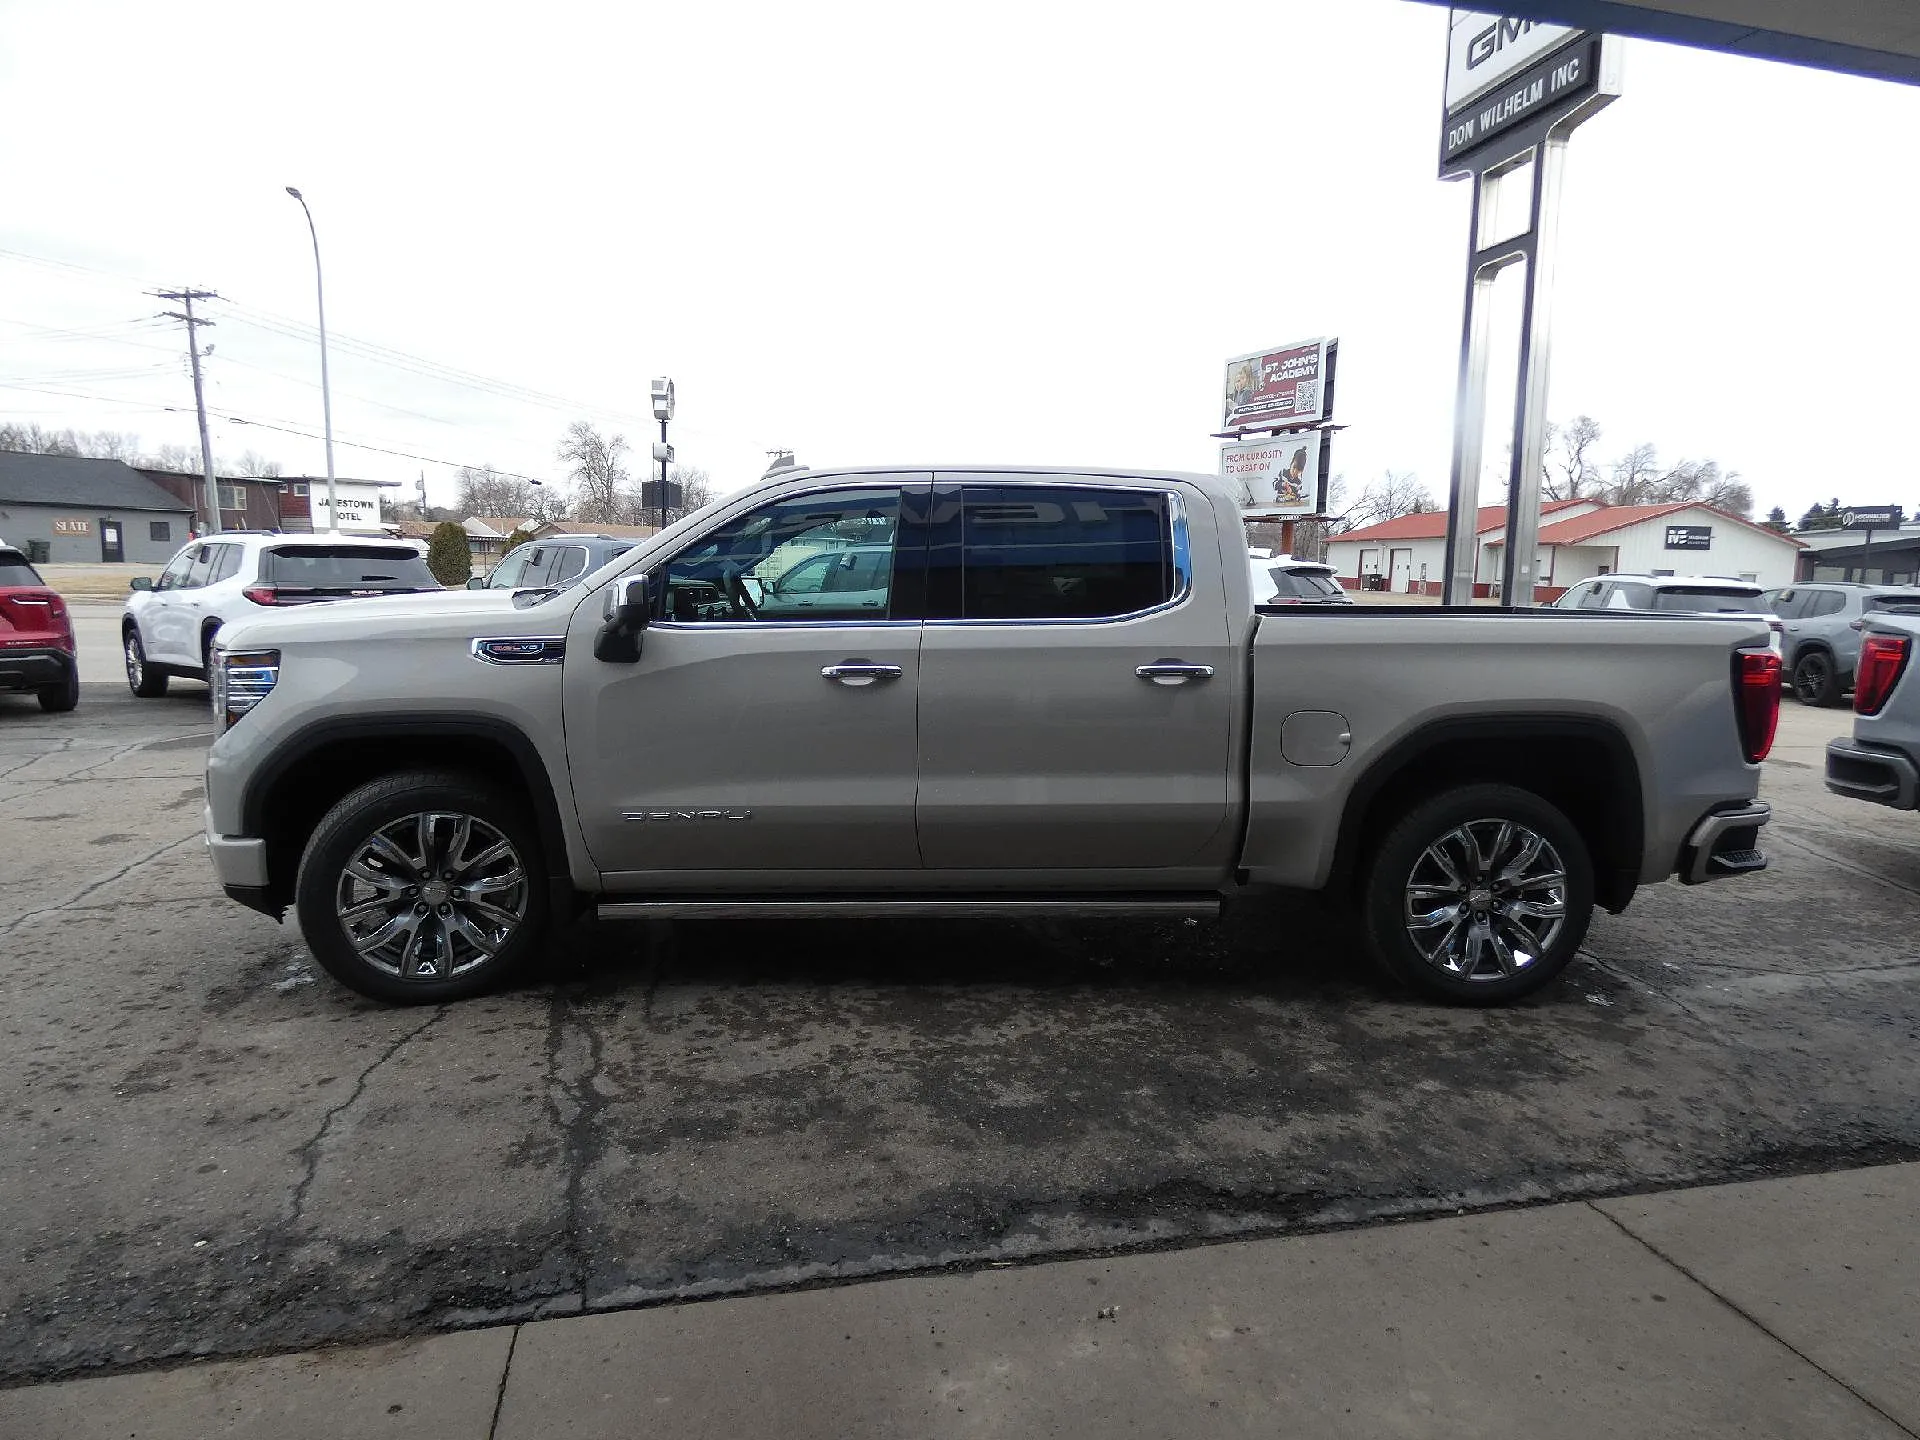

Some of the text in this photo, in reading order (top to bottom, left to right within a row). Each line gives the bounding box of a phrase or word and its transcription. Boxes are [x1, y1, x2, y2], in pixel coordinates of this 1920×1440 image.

[1466, 16, 1539, 70] GM
[1448, 58, 1580, 150] DON WILHELM INC
[1265, 353, 1318, 373] ST. JOHN'S
[1269, 364, 1317, 382] ACADEMY
[1226, 449, 1283, 463] FROM CURIOSITY
[1226, 462, 1271, 474] TO CREATION
[318, 498, 374, 509] JAESTOWN
[336, 512, 362, 521] OTEL
[55, 521, 89, 532] SLATE
